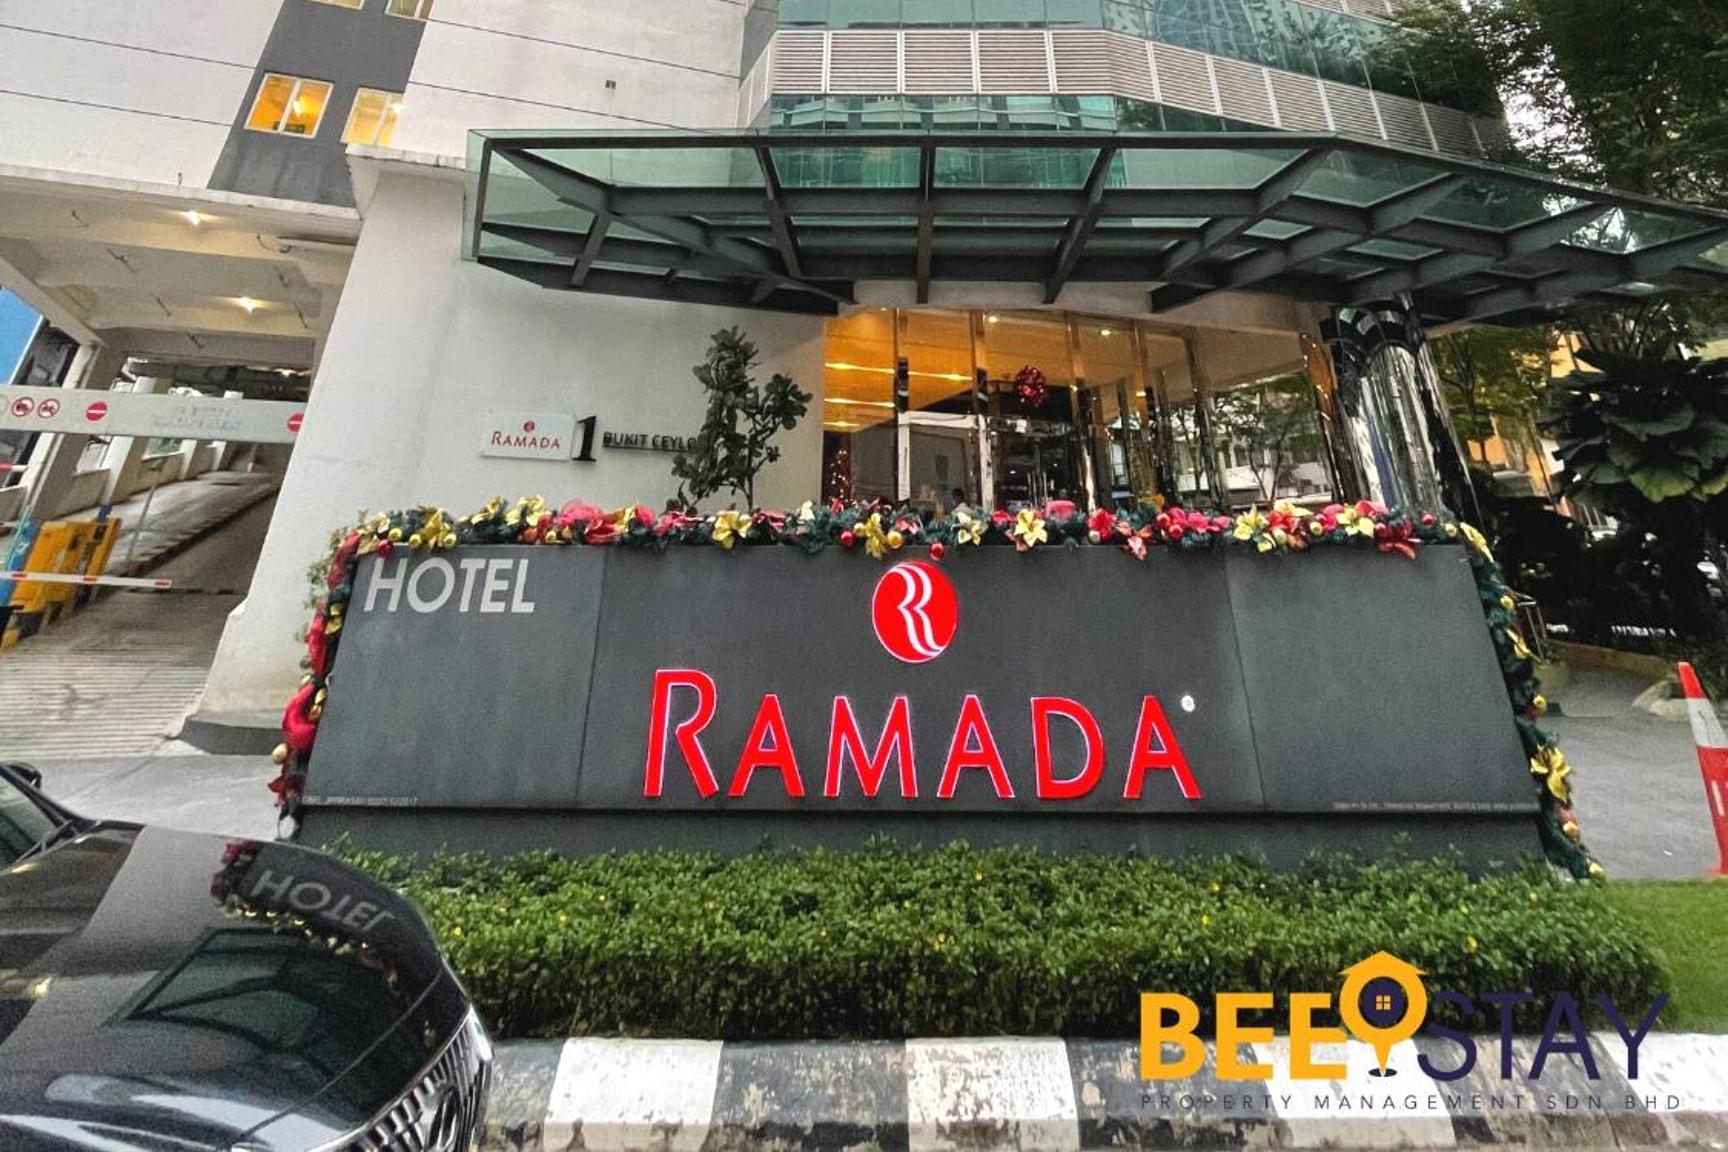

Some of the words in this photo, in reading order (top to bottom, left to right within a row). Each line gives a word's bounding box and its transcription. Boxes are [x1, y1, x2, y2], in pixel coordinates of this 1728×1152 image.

[490, 430, 561, 451] RAMADA
[571, 415, 597, 462] 1
[602, 431, 648, 448] BUKIT
[651, 434, 697, 451] CEYLO
[363, 558, 536, 614] HOTEL
[643, 667, 1201, 801] RAMADA
